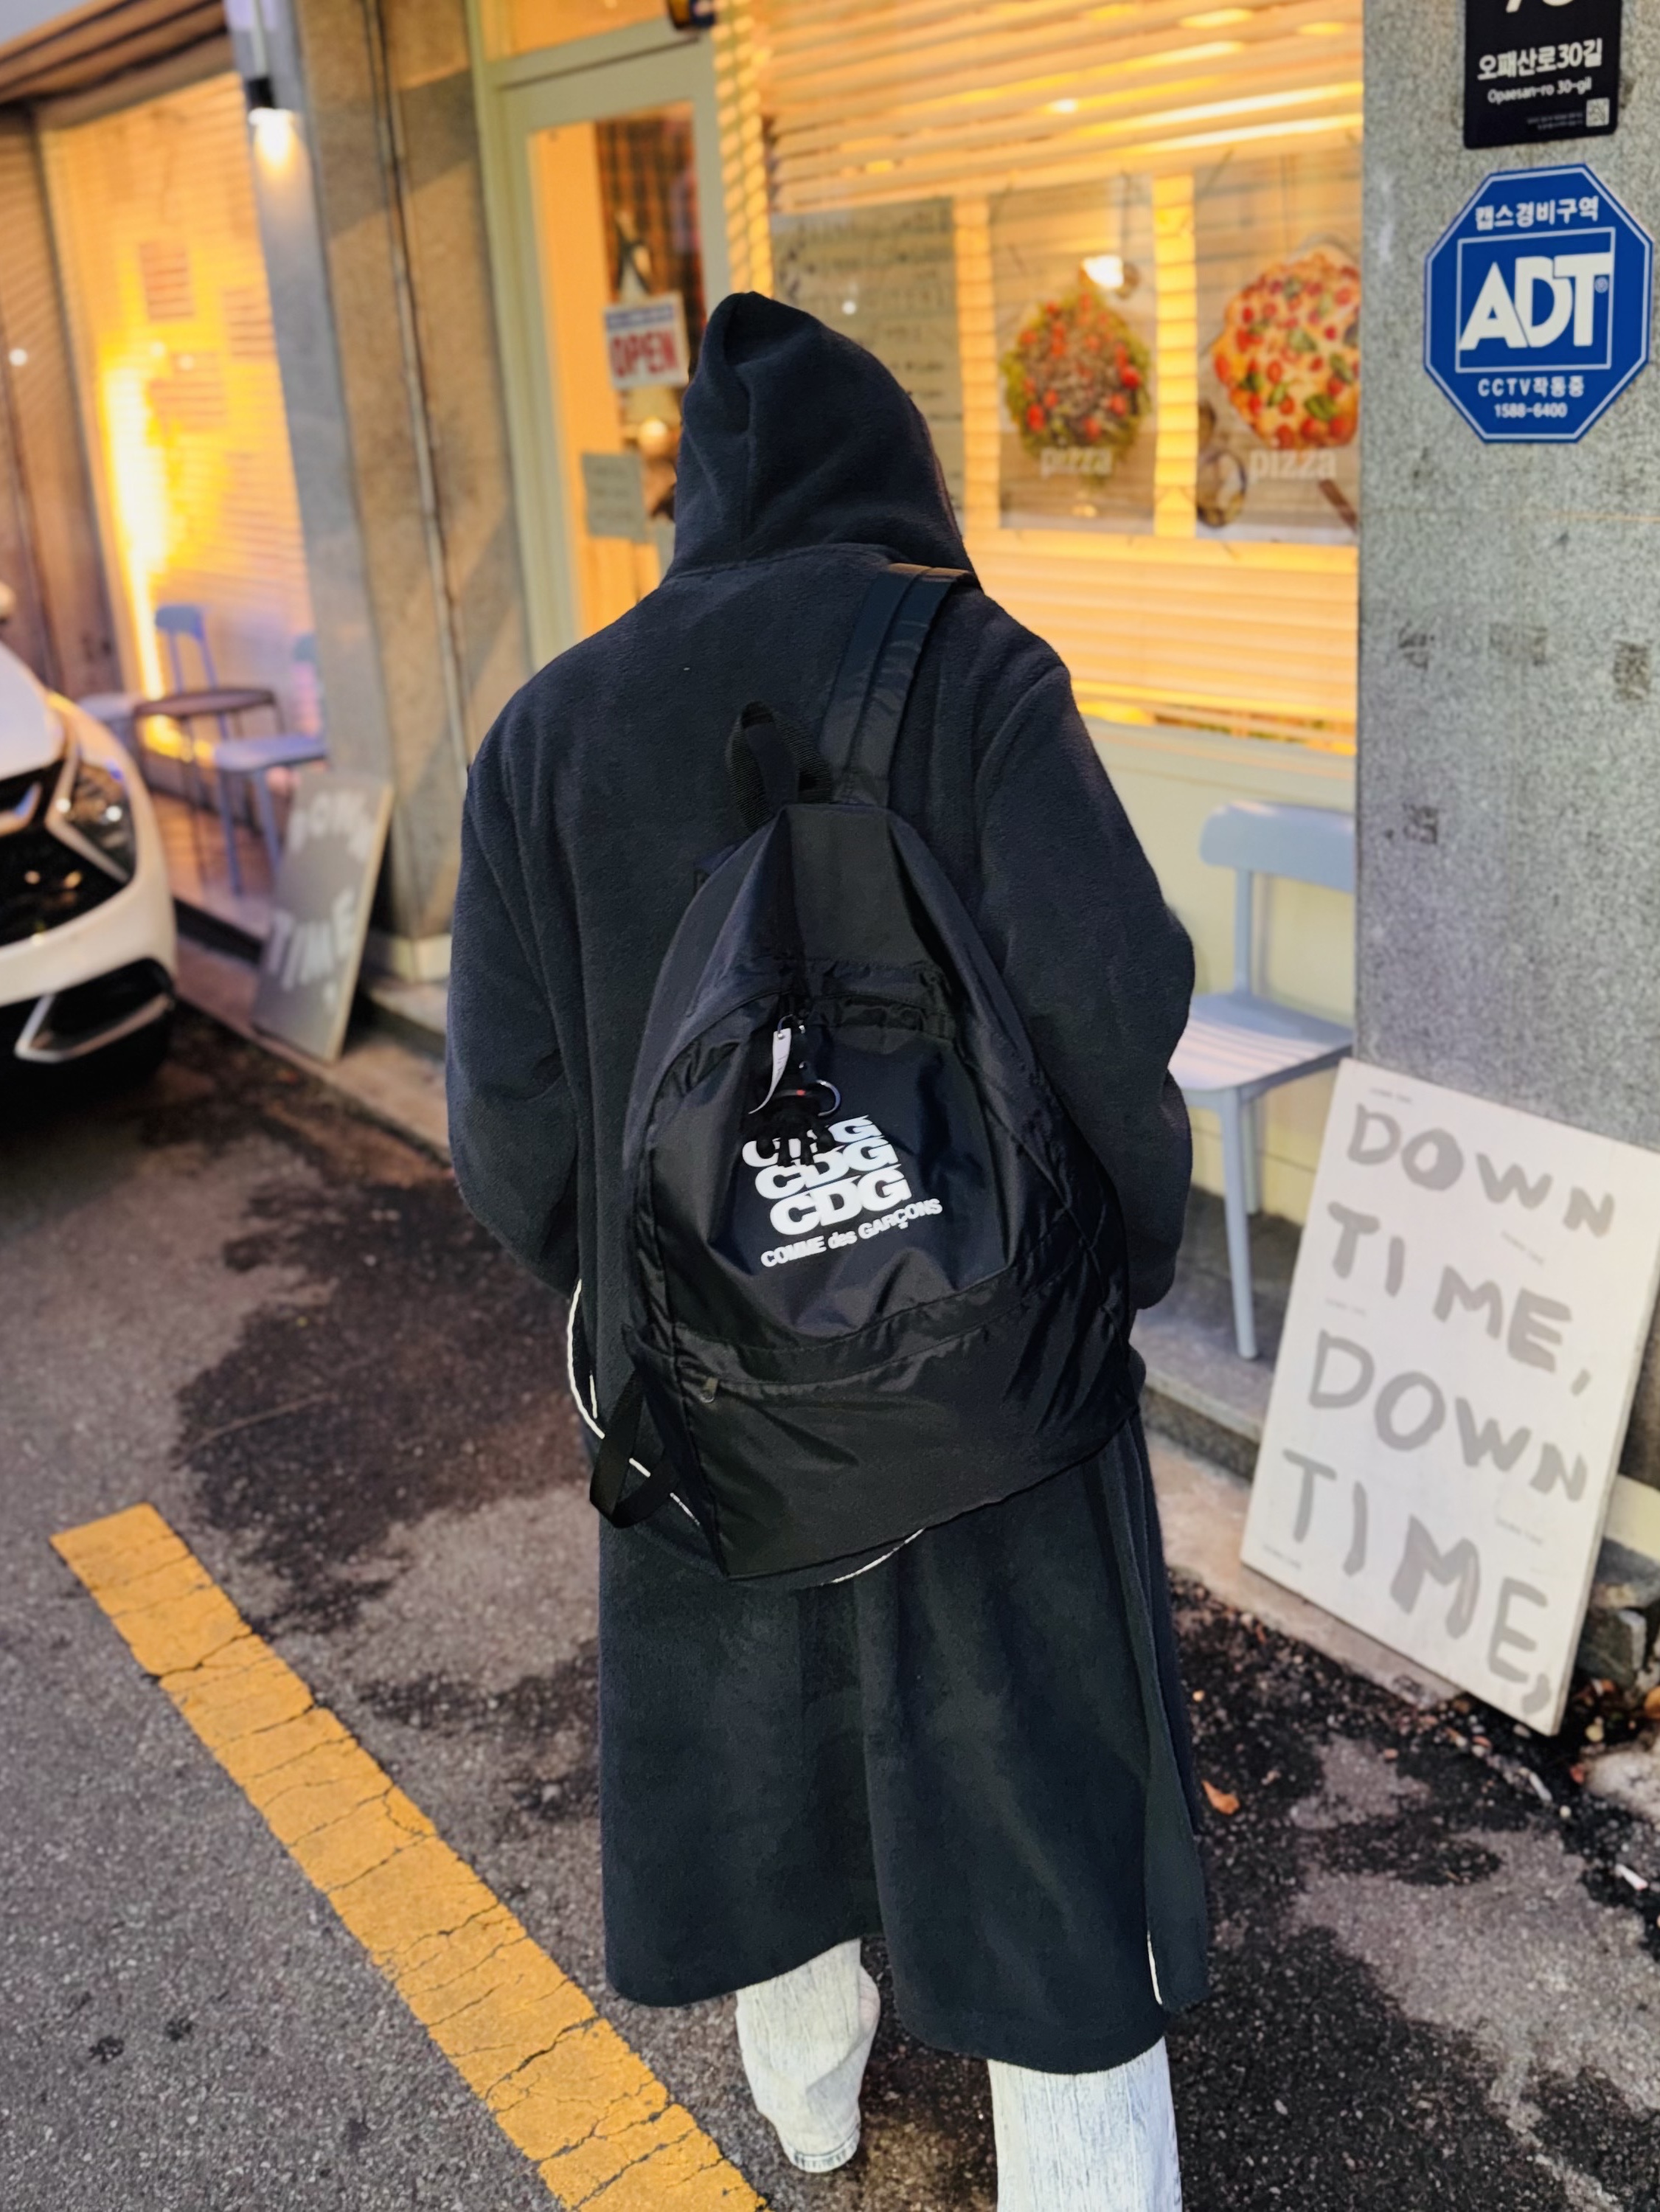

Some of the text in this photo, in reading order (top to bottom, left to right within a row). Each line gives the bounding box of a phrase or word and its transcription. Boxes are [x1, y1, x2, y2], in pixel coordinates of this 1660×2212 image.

[1477, 38, 1603, 81] 오패산로30길
[1487, 76, 1592, 105] Opaesan-ro 30-gil
[1476, 196, 1600, 231] 캡스경비구역
[610, 325, 679, 378] OPEN
[1493, 401, 1568, 418] 1588-6400
[1251, 448, 1338, 479] pizza
[755, 1136, 899, 1199] CDG
[1347, 1104, 1615, 1238] DOWN
[770, 1163, 912, 1235] CDG
[760, 1235, 827, 1268] COMME
[827, 1230, 858, 1249] des
[1308, 1330, 1588, 1502] DOWN
